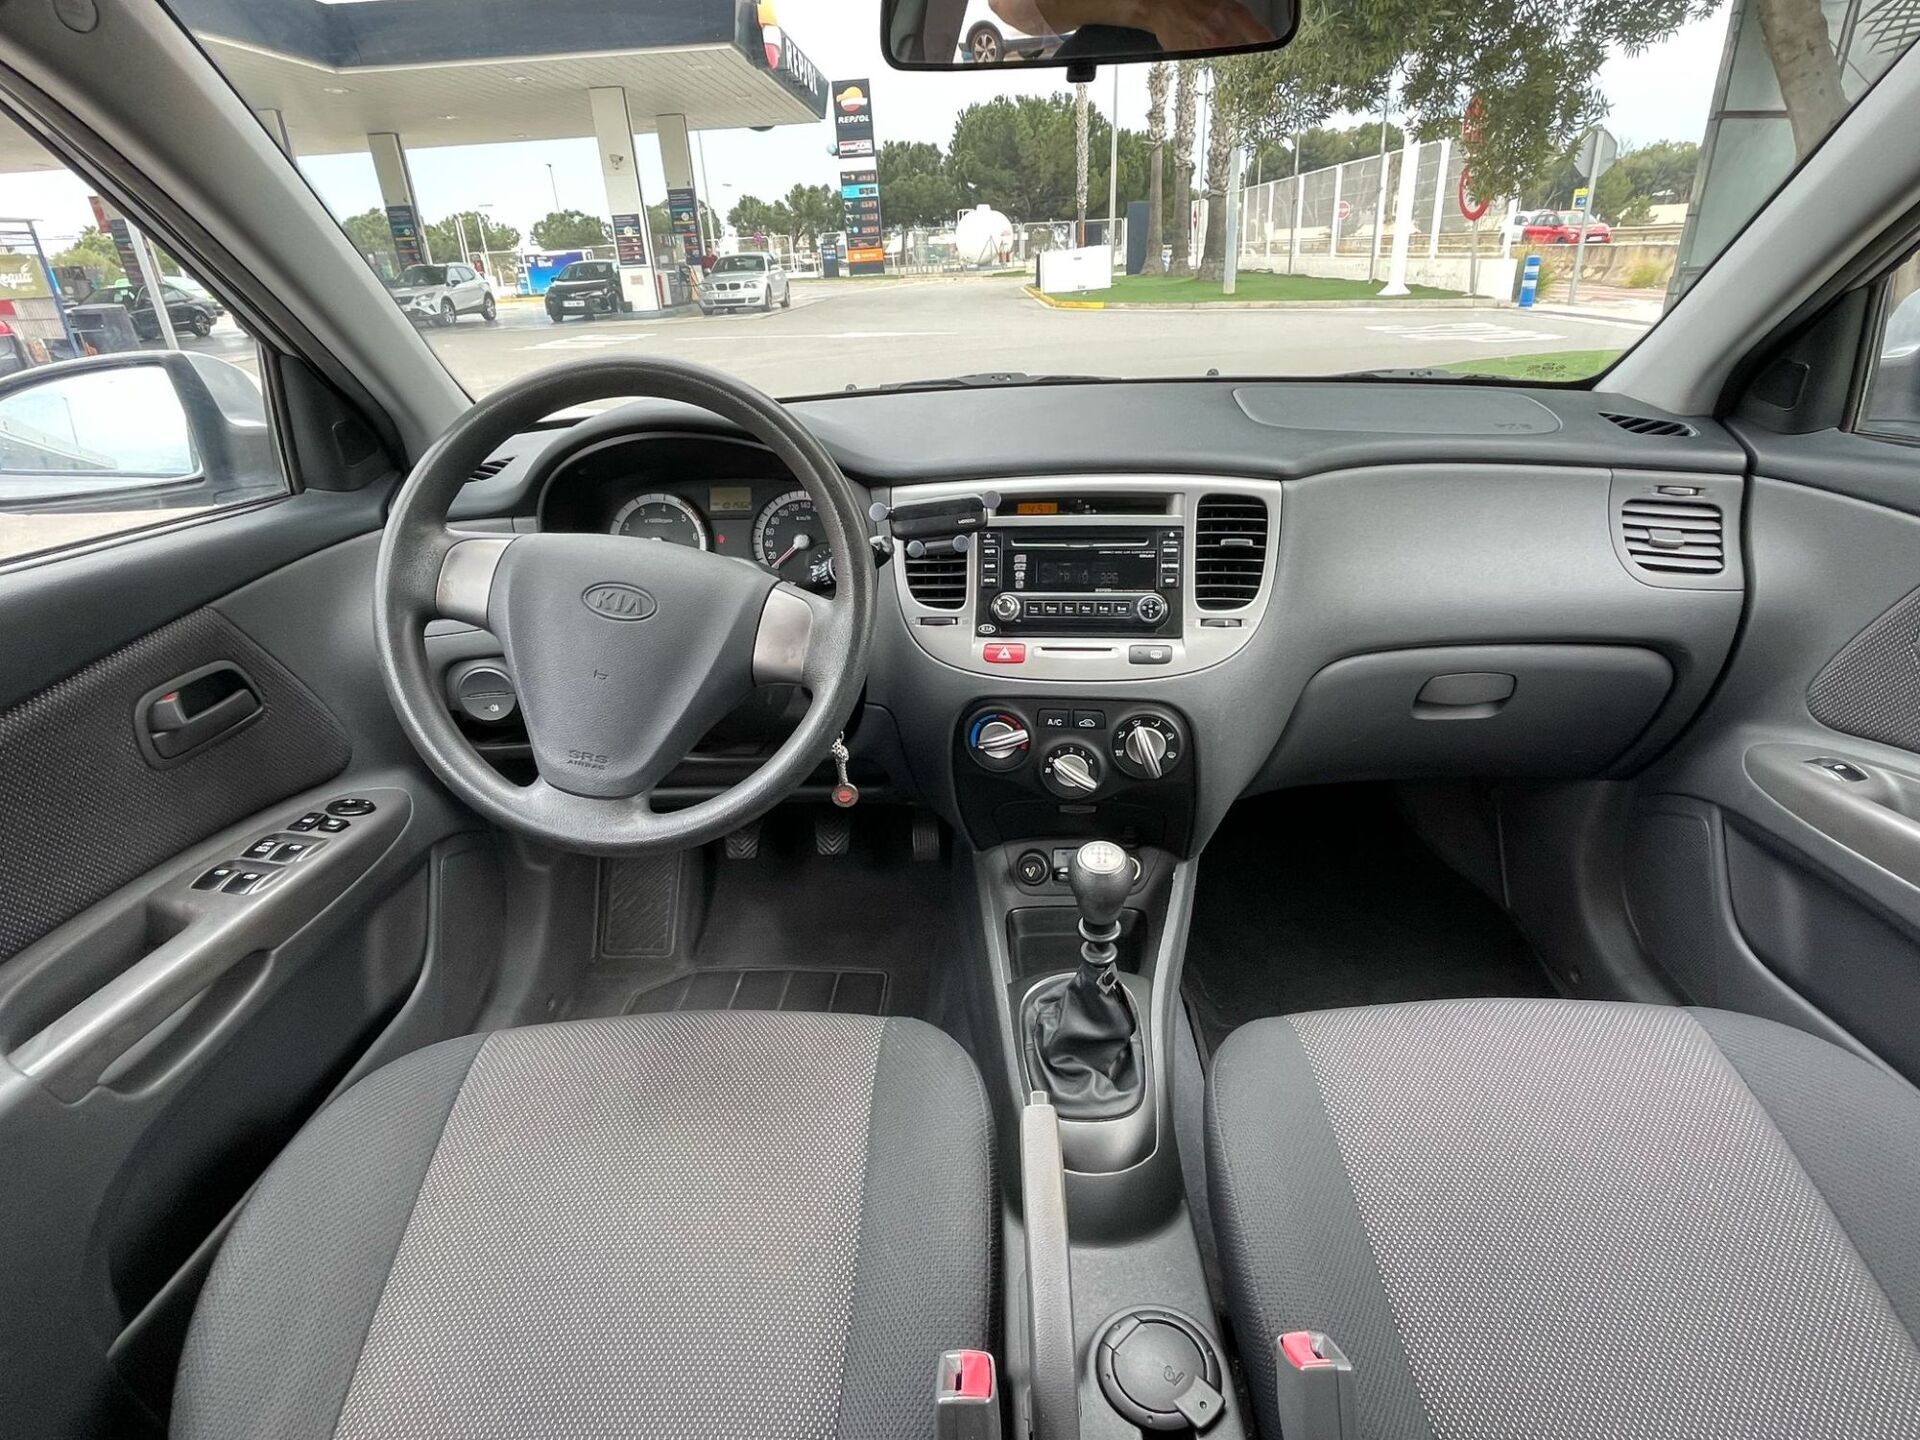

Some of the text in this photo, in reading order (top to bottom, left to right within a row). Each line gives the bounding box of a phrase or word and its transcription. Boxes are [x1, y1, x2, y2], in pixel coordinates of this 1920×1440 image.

[838, 115, 870, 124] REPSOL
[788, 503, 799, 511] 120
[778, 509, 789, 517] 100
[771, 516, 780, 525] 80
[765, 527, 775, 536] 60
[764, 540, 774, 548] 40
[767, 551, 777, 560] 20
[596, 591, 643, 616] KIA
[1047, 718, 1062, 726] A/C
[568, 750, 608, 764] SRS
